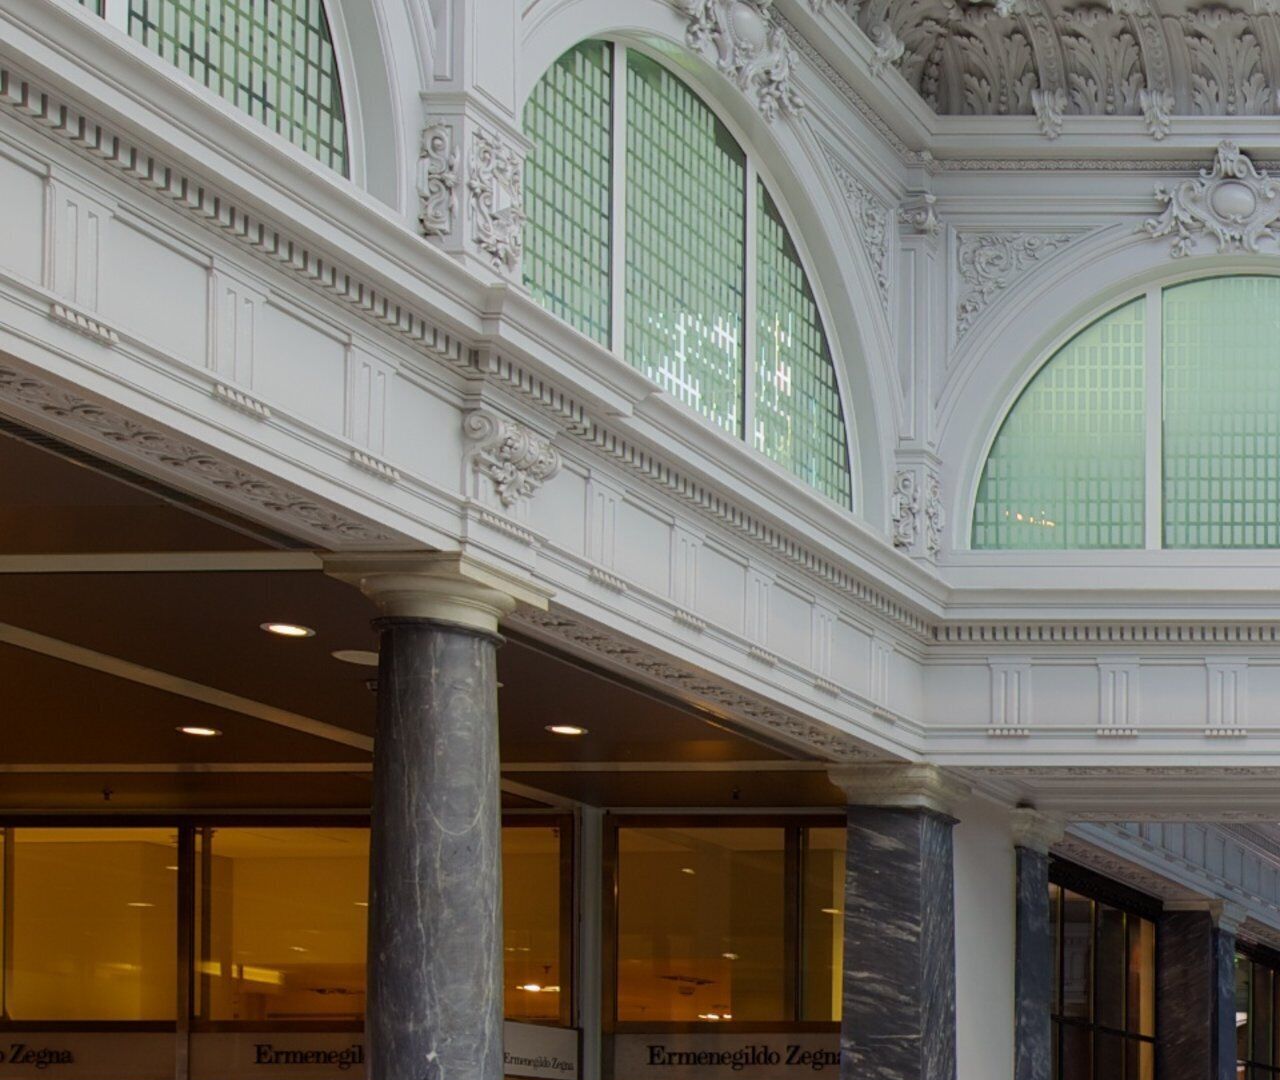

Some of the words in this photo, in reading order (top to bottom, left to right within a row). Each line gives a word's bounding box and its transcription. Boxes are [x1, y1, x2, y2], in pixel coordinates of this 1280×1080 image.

[9, 1044, 74, 1069] Zegna
[254, 1044, 364, 1070] Ermenegil
[646, 1045, 780, 1071] Ermenegildo
